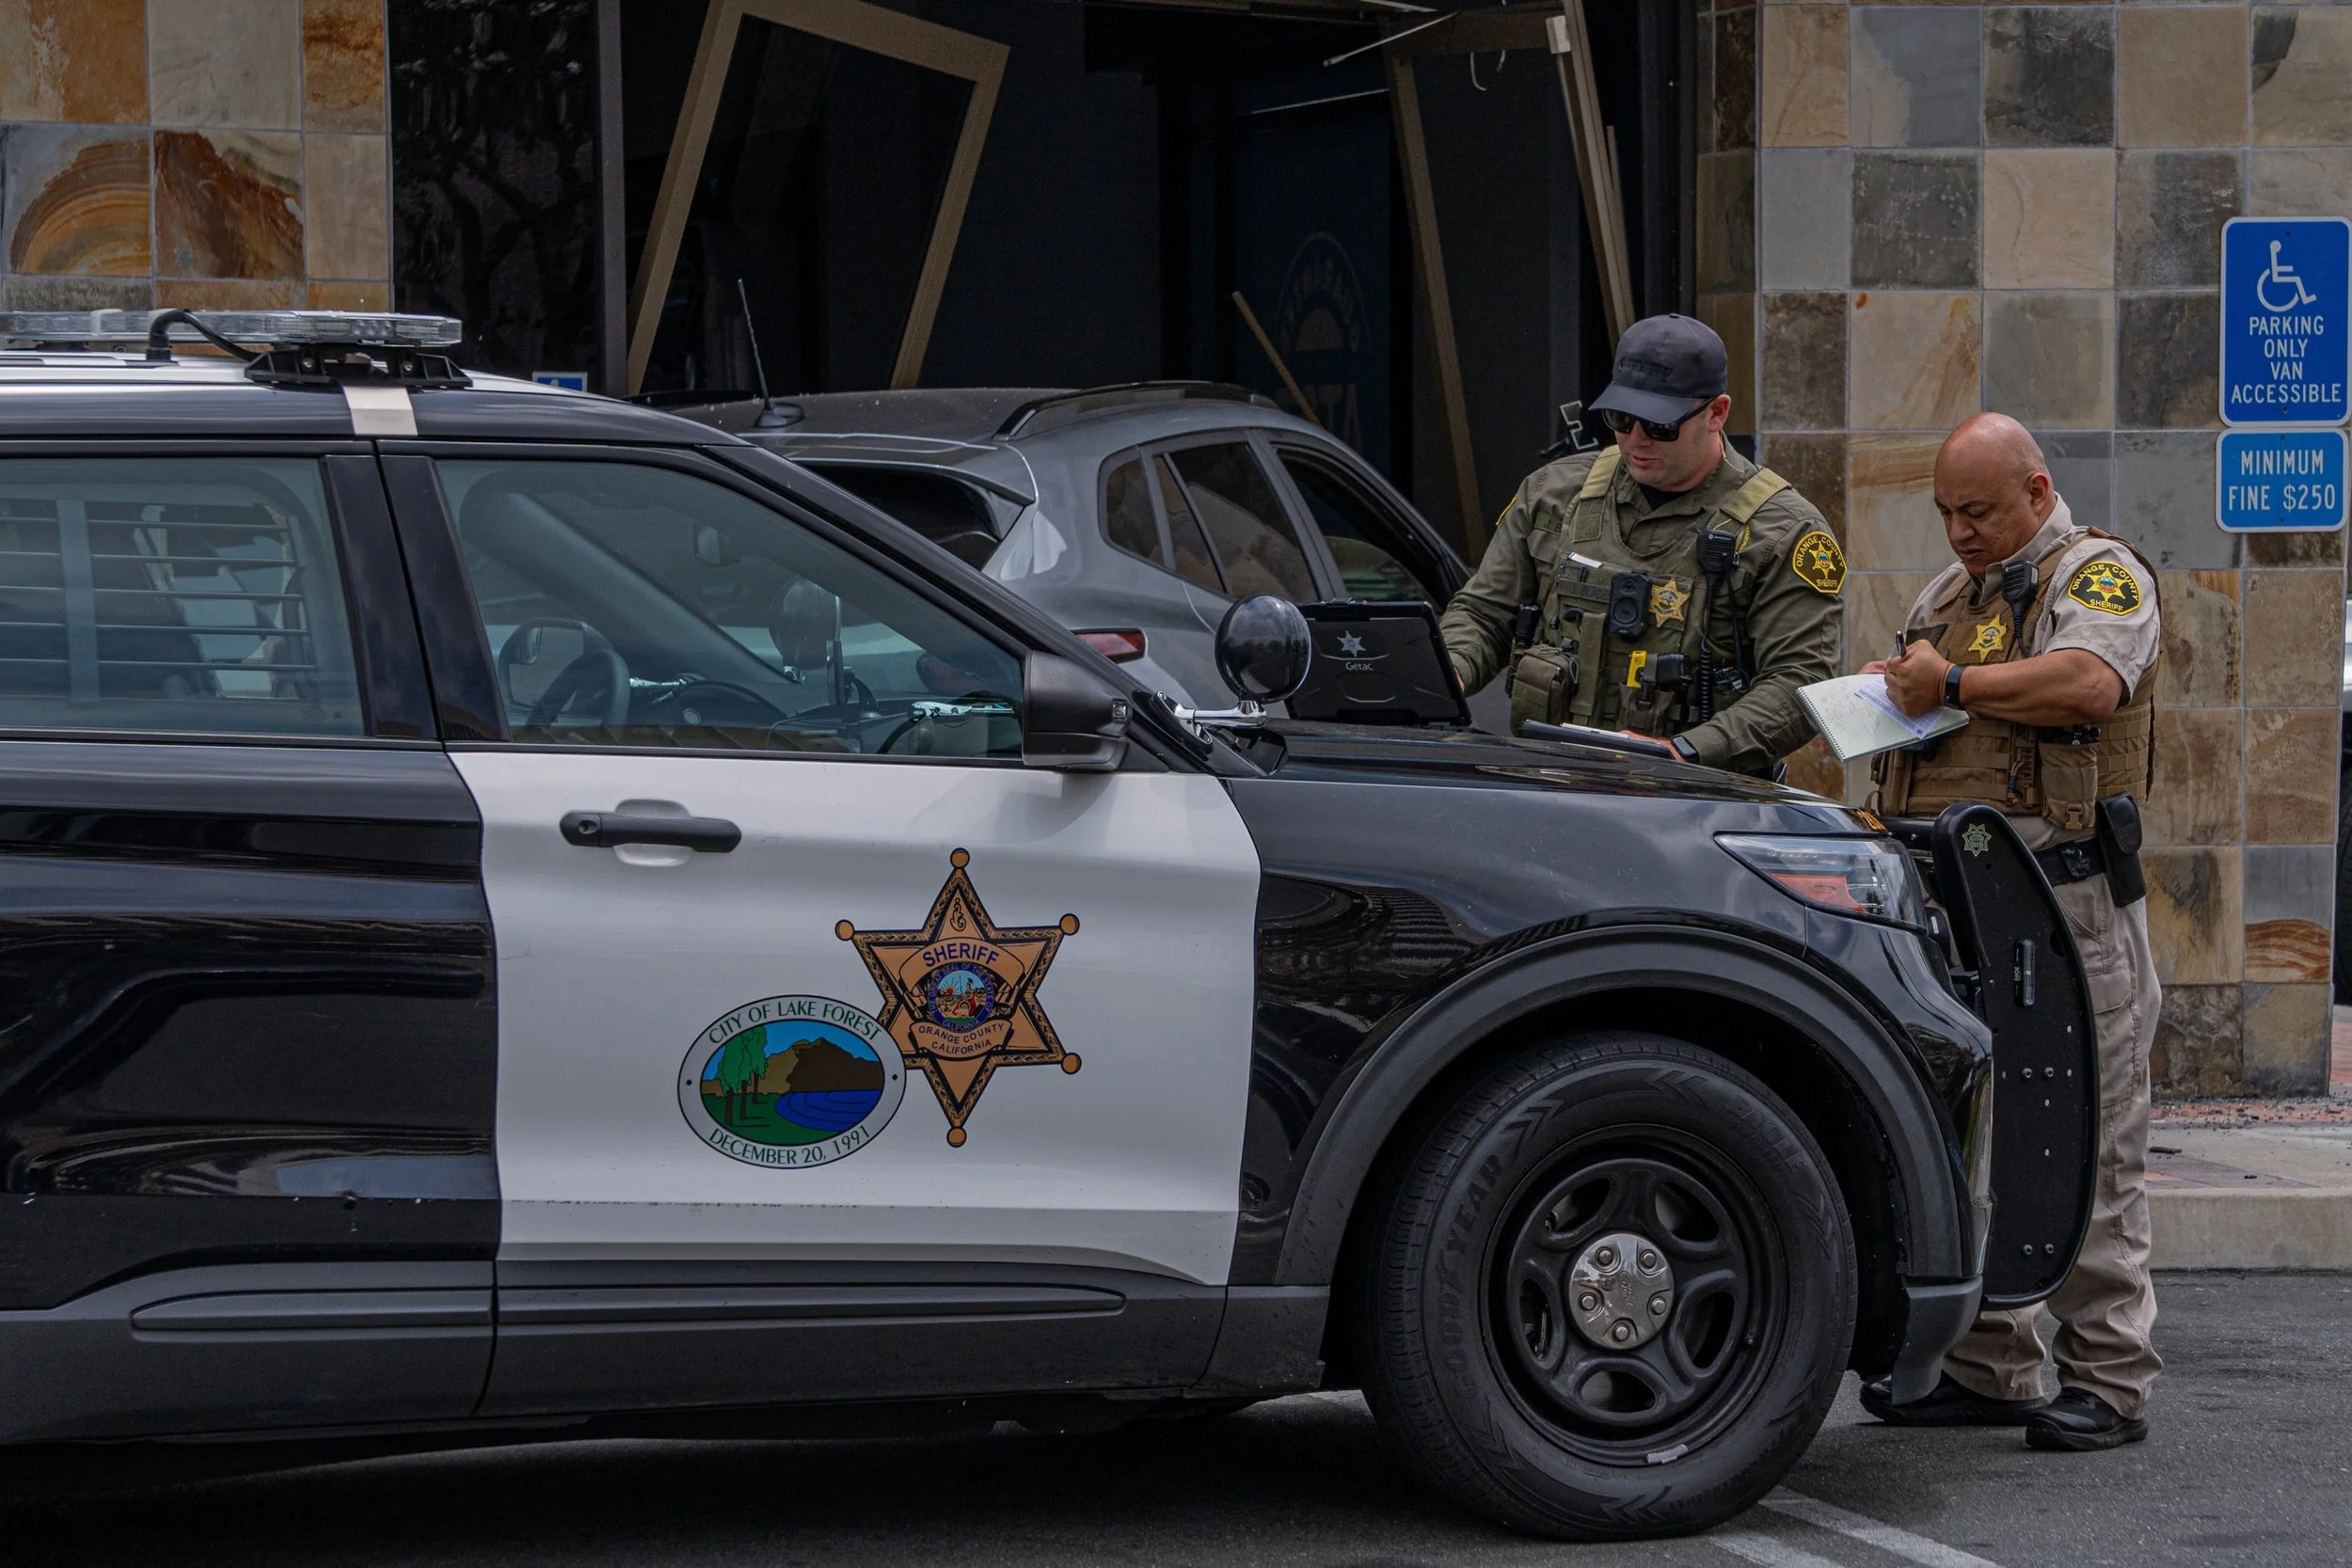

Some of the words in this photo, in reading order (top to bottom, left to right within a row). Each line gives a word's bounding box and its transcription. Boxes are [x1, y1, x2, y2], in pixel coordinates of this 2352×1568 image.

[2249, 315, 2324, 336] PARKING
[2264, 339, 2309, 357] ONLY
[2270, 361, 2303, 380] VAN
[2231, 384, 2342, 404] ACCESSIBLE
[2241, 449, 2325, 475] MINIMUM
[2229, 485, 2270, 511] FINE
[2282, 483, 2336, 513] $250
[1796, 536, 1819, 567] ORANGE
[1816, 578, 1837, 588] SHERIFF
[2072, 564, 2105, 591] ORANGE
[2111, 566, 2138, 601] COUNTY
[2090, 598, 2123, 612] SHERIFF
[1345, 661, 1373, 671] Getac
[923, 942, 999, 967] SHERIFF
[709, 1013, 742, 1043] CITY
[748, 1004, 771, 1022] OF
[778, 1000, 817, 1017] LAKE
[822, 1003, 882, 1041] FOREST
[918, 1025, 960, 1044] ORANGE
[963, 1022, 1004, 1043] COUNTY
[931, 1038, 993, 1054] CALIFORNIA
[708, 1128, 797, 1164] DECEMBER
[802, 1147, 827, 1164] 20,
[833, 1125, 870, 1155] 1991
